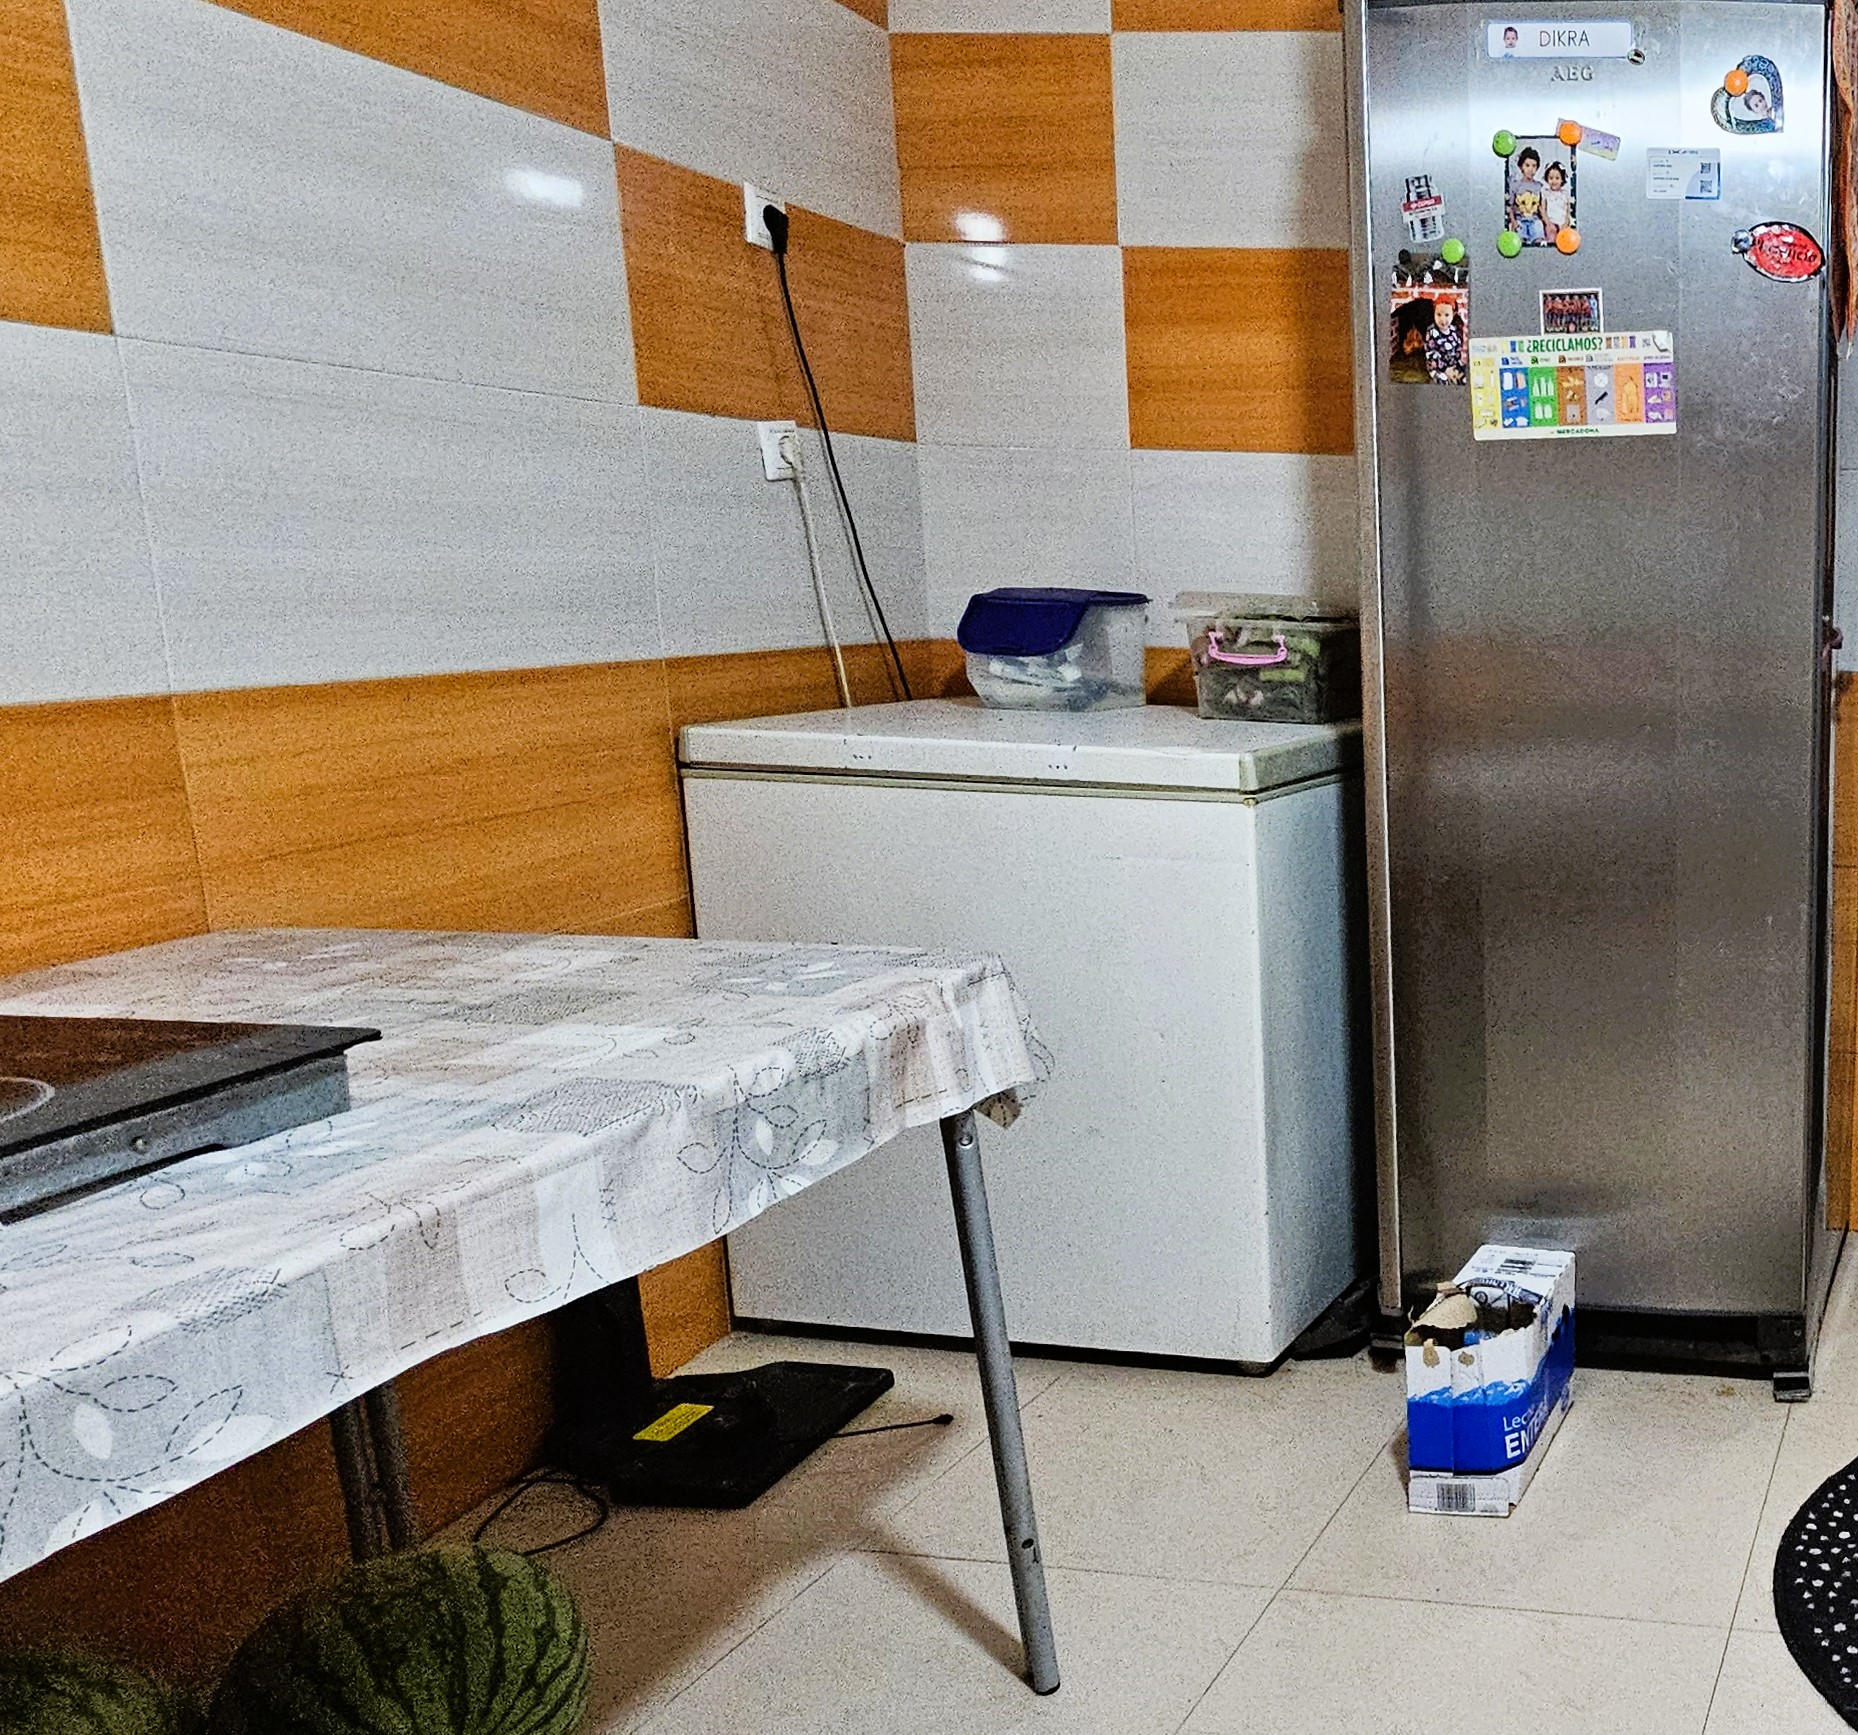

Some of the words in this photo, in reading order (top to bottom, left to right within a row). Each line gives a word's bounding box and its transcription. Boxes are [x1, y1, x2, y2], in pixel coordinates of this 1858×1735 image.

[1539, 29, 1590, 48] DIKRA
[1551, 64, 1594, 82] AEG
[1526, 336, 1603, 353] ¿RECICLAMOS?
